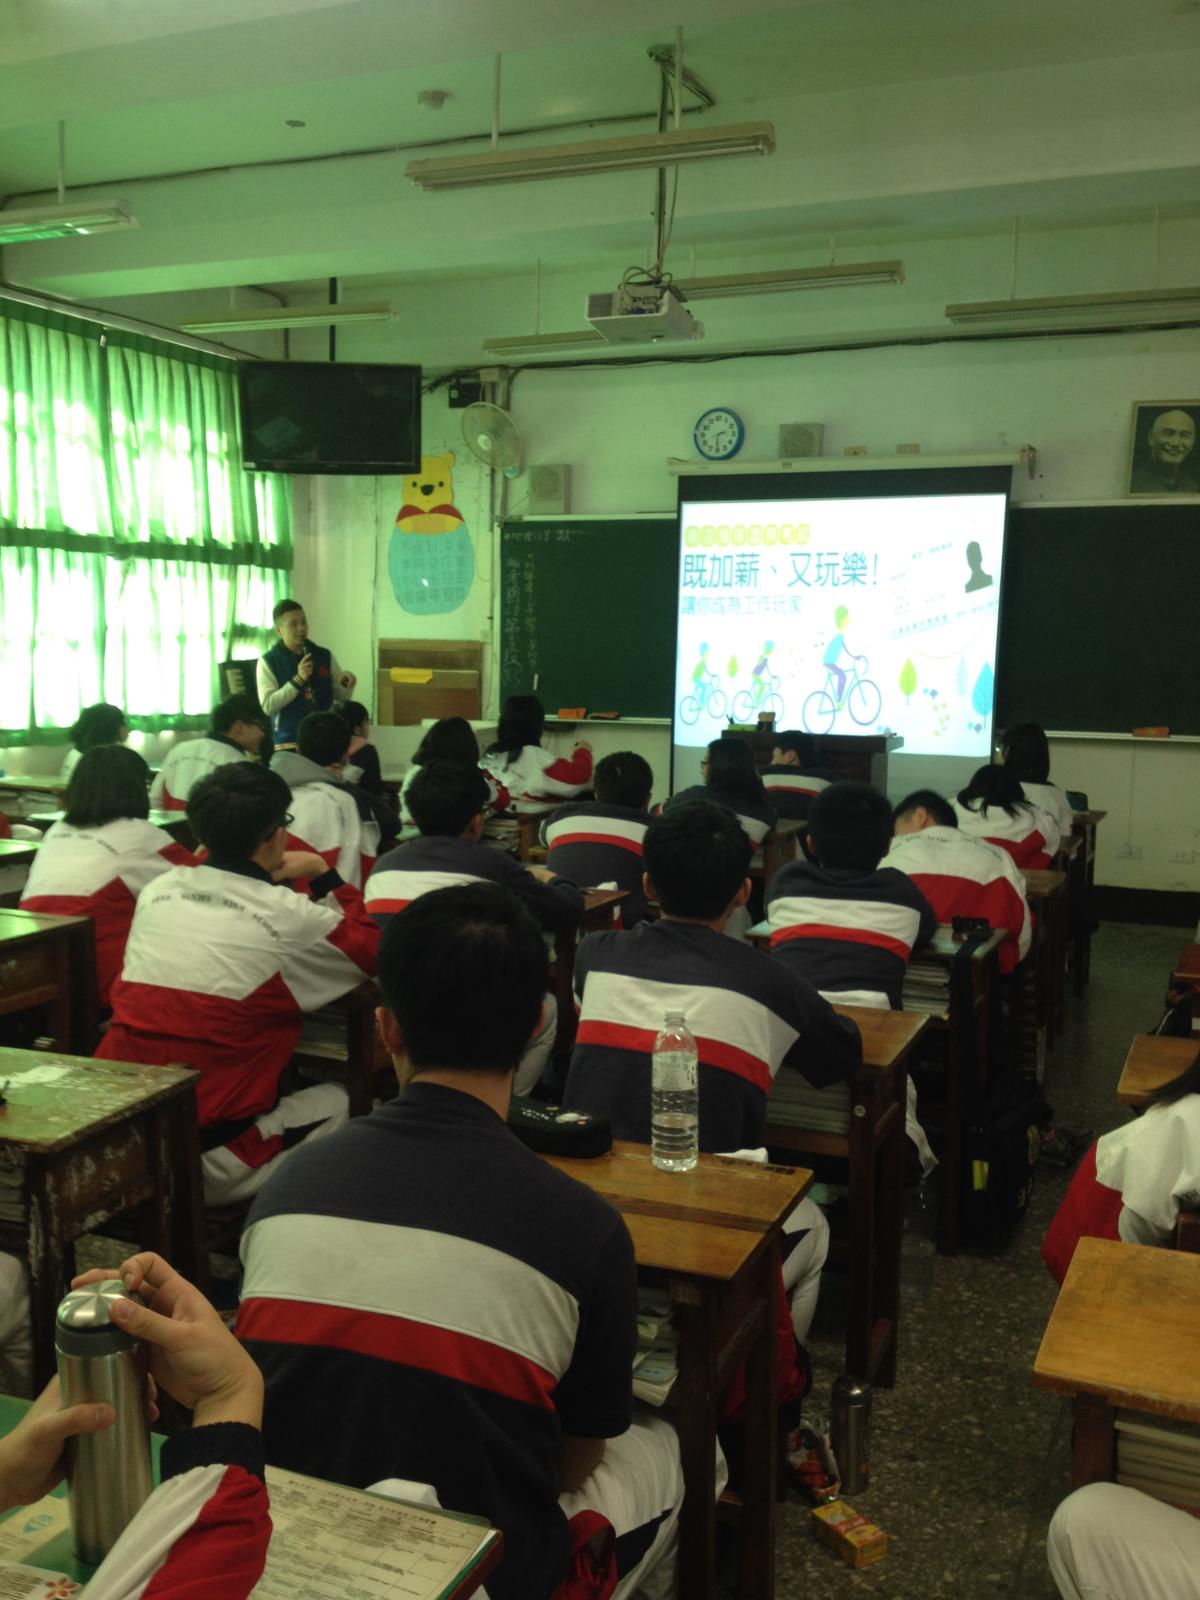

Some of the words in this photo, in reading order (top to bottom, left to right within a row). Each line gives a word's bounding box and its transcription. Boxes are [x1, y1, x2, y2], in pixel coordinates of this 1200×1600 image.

[682, 551, 878, 588] 既加薪、又玩樂!
